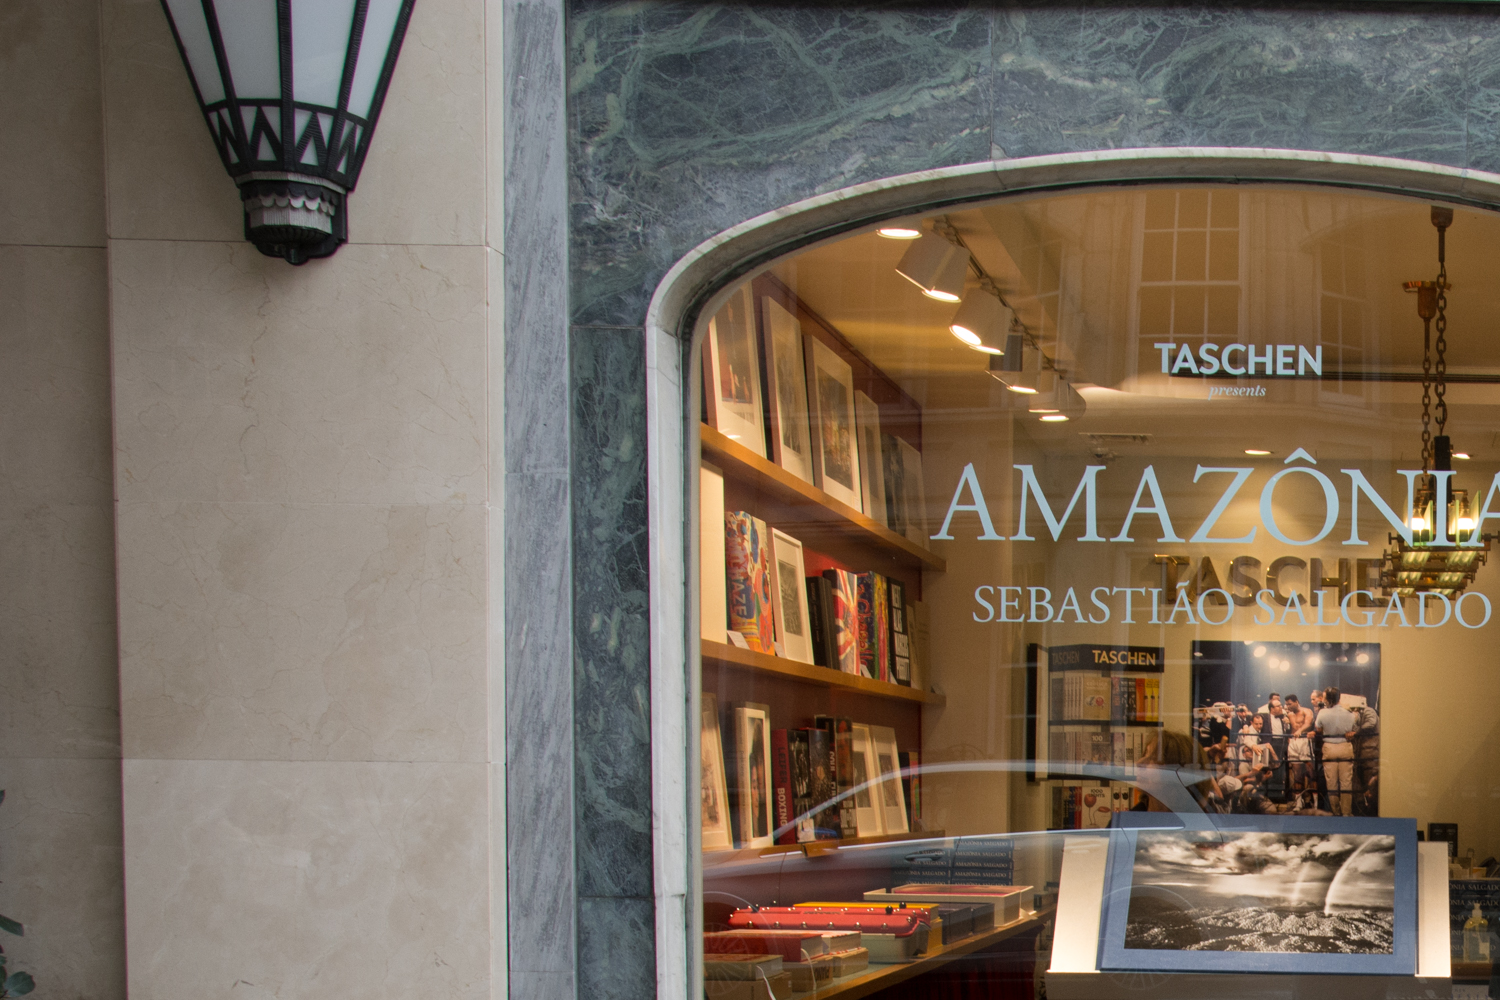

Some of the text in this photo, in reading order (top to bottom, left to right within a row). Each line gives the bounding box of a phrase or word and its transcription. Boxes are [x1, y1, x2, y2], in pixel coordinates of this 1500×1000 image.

[1155, 342, 1323, 377] TASCHEN
[1208, 382, 1267, 401] presents
[1155, 556, 1428, 607] TASCHE
[972, 581, 1492, 630] SEBASTIÃO SALGADO
[1052, 649, 1156, 666] TASCHEN TASCHEN
[777, 747, 788, 826] LEIFER BOXING
